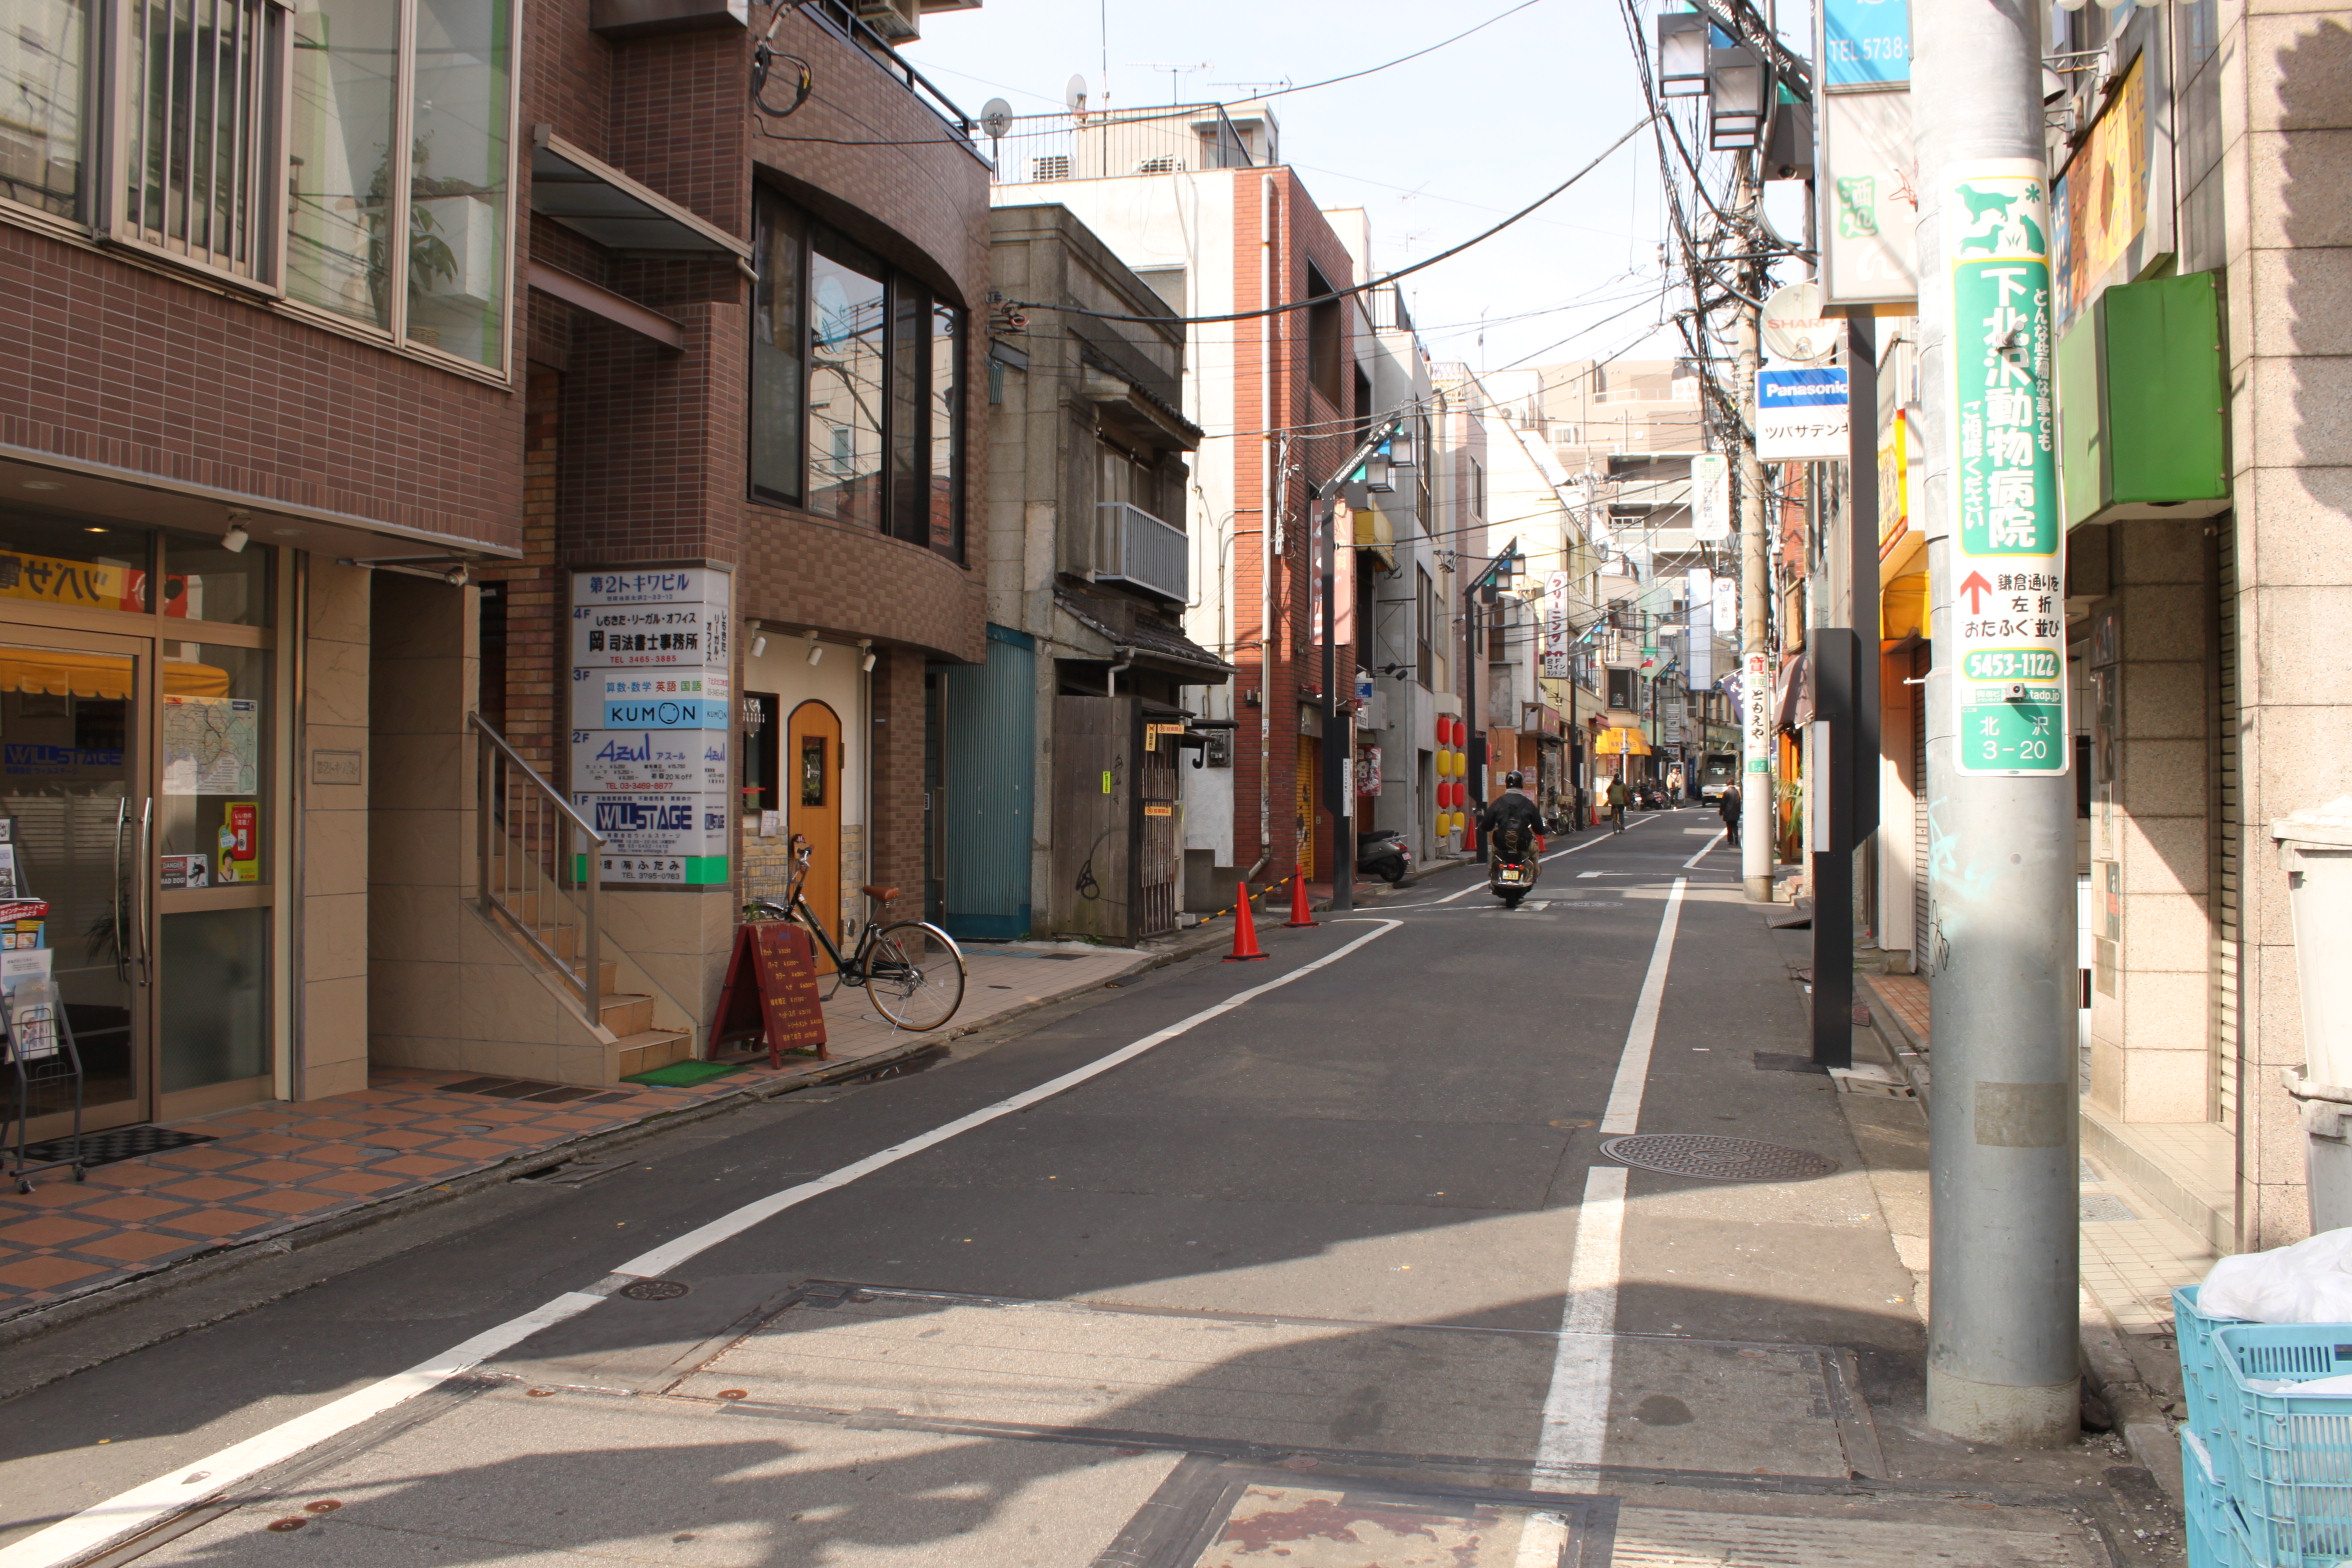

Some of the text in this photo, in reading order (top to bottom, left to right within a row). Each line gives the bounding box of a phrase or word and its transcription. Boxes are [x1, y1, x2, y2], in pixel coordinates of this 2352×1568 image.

[1829, 40, 1860, 63] TEL
[1767, 319, 1835, 330] SHARP
[1766, 380, 1849, 397] Panasonic
[1980, 266, 2037, 549] 下北沢動物病院
[1961, 400, 1985, 531] ご相談ください
[589, 573, 690, 594] 第2トキワビル
[1998, 573, 2060, 593] 鎌倉通りを
[573, 607, 591, 620] 4F
[1552, 578, 1562, 643] クリーニング
[589, 630, 698, 652] 岡 司法書士事務所
[1749, 655, 1765, 675] 質
[1970, 653, 2056, 677] 5453-1122
[573, 670, 590, 681] 3F
[606, 681, 652, 693] 算数・数学
[655, 681, 677, 692] 英語
[680, 680, 702, 692] 国語
[2029, 689, 2061, 702] tadp.jp
[611, 702, 696, 725] KUMON
[1751, 688, 1765, 740] ともえや
[572, 732, 590, 743] 2F
[595, 732, 651, 762] Azul
[704, 742, 726, 762] Azul
[605, 782, 618, 790] TEL
[573, 794, 589, 806] 1F
